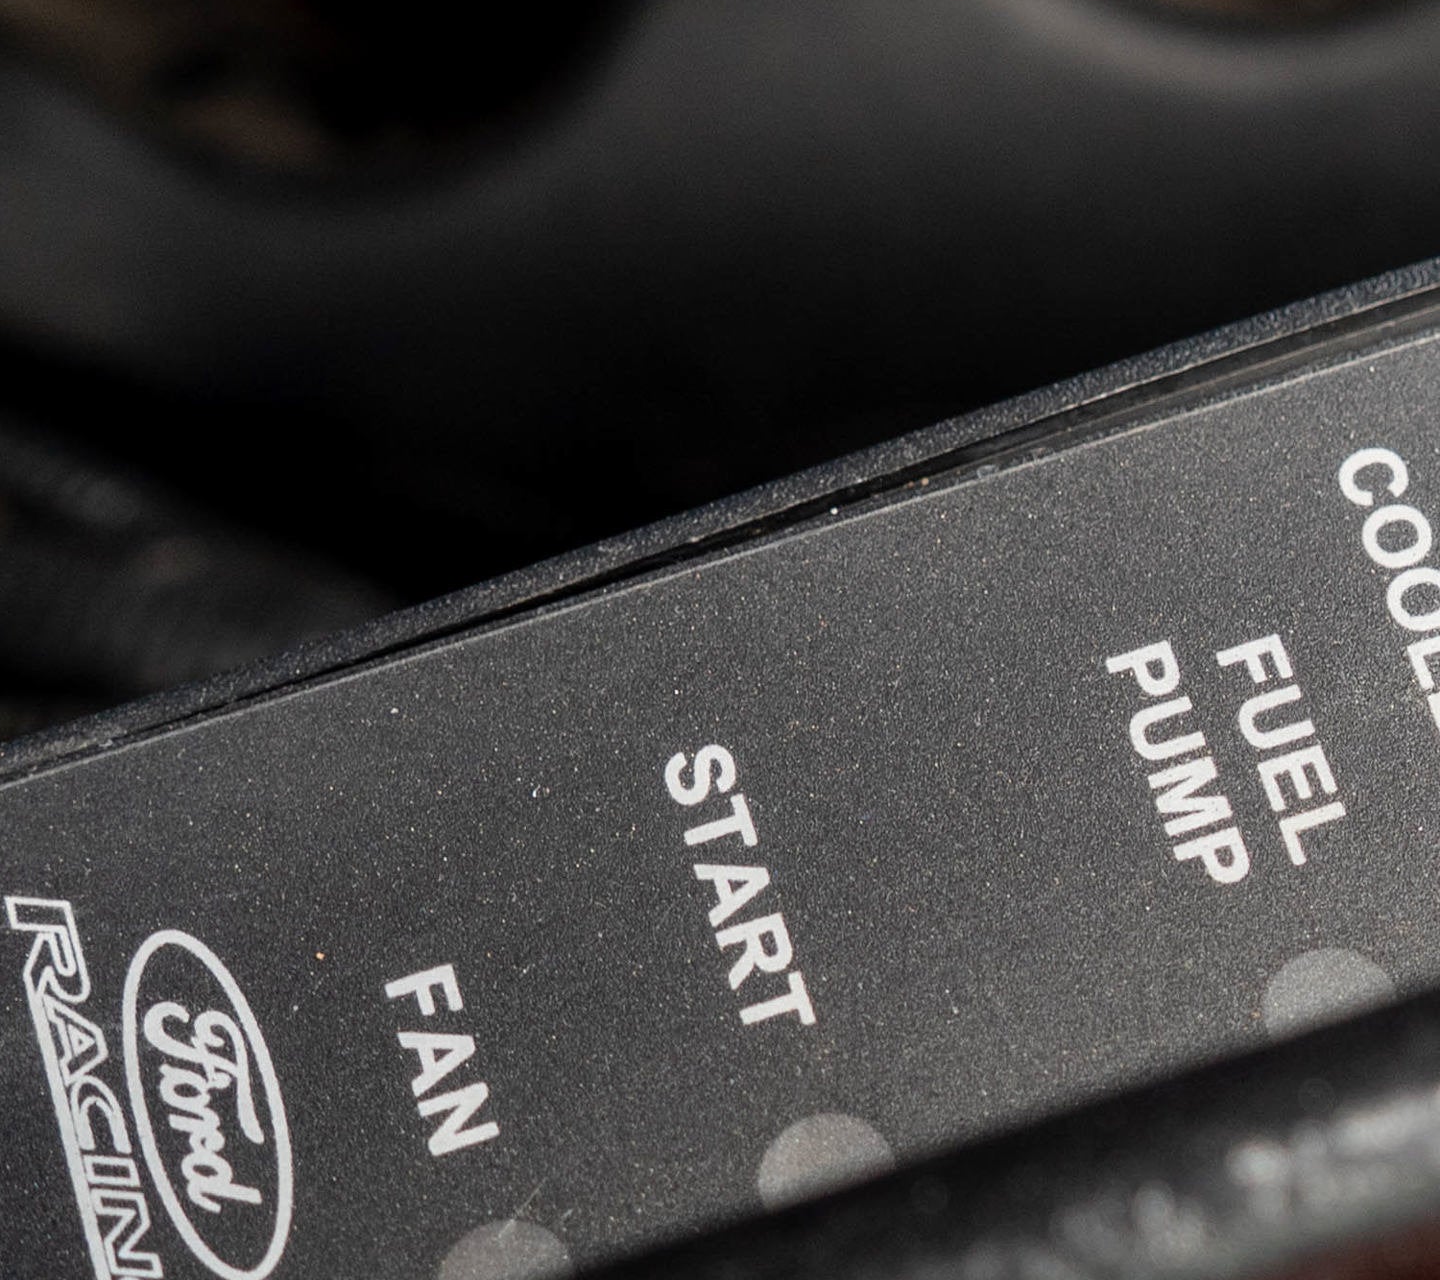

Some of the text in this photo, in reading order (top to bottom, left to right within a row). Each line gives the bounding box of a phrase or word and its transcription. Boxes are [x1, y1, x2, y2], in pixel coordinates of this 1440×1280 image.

[1105, 638, 1252, 886] PUMP
[1214, 633, 1344, 868] FUEL
[665, 744, 816, 1024] START
[143, 1001, 264, 1213] Ford
[386, 966, 500, 1155] FAN
